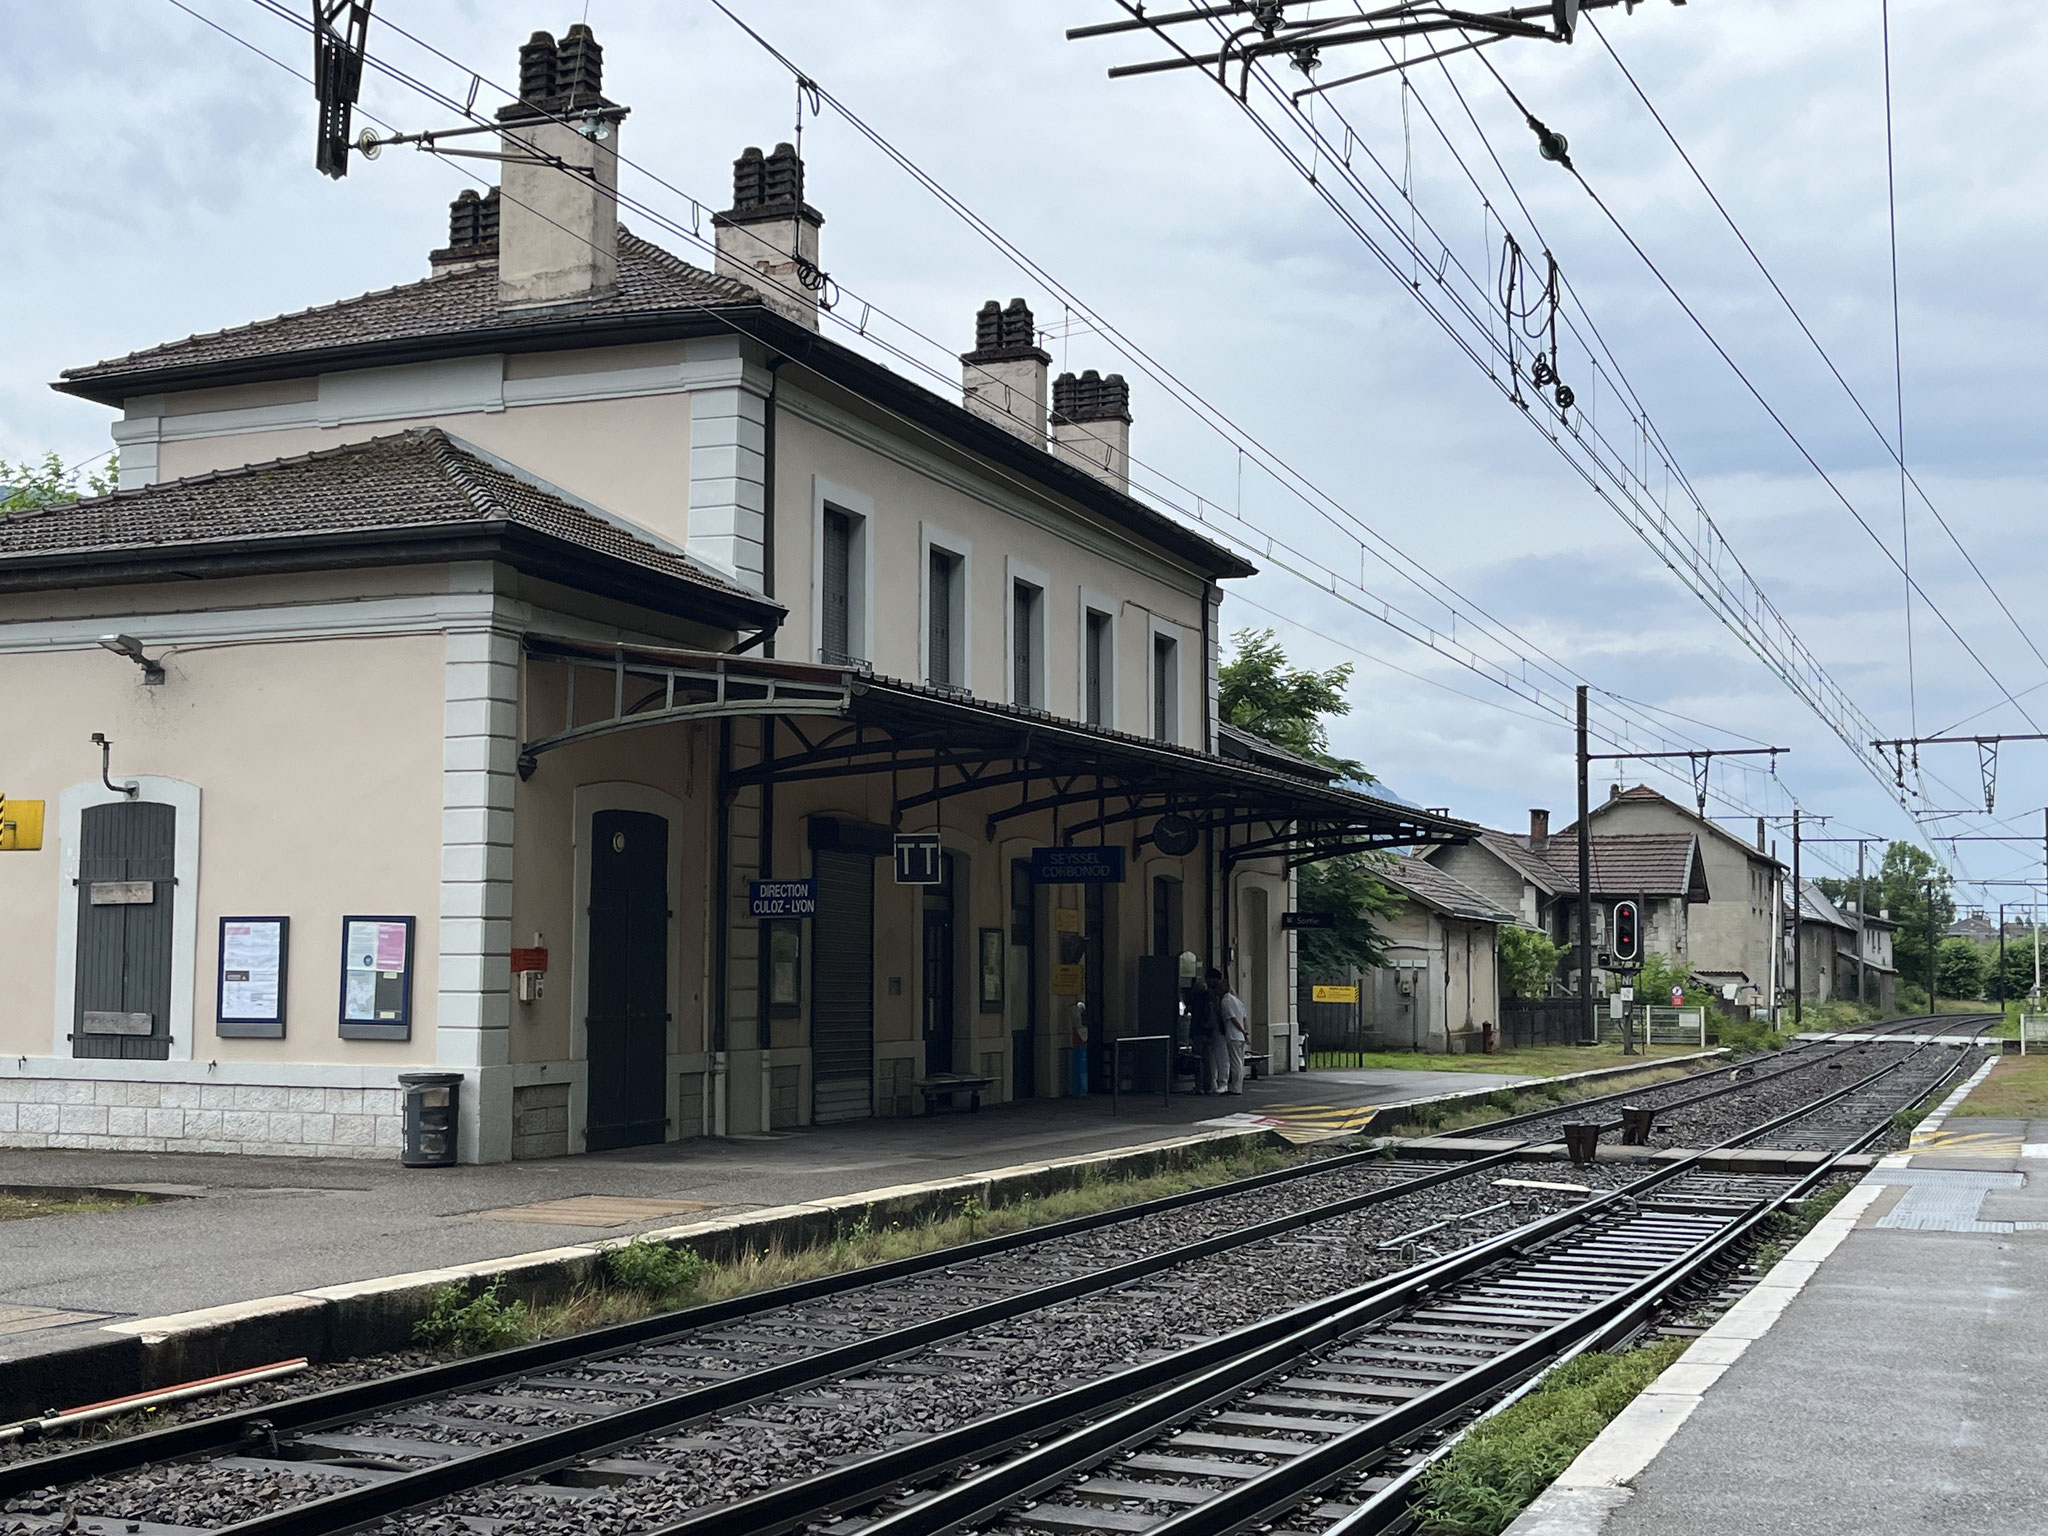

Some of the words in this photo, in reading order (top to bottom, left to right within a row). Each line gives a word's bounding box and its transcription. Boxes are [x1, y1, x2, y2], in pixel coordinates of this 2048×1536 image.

[898, 843, 937, 875] TT
[1050, 852, 1101, 864] SEYSSEL
[760, 884, 808, 898] DIRECTION
